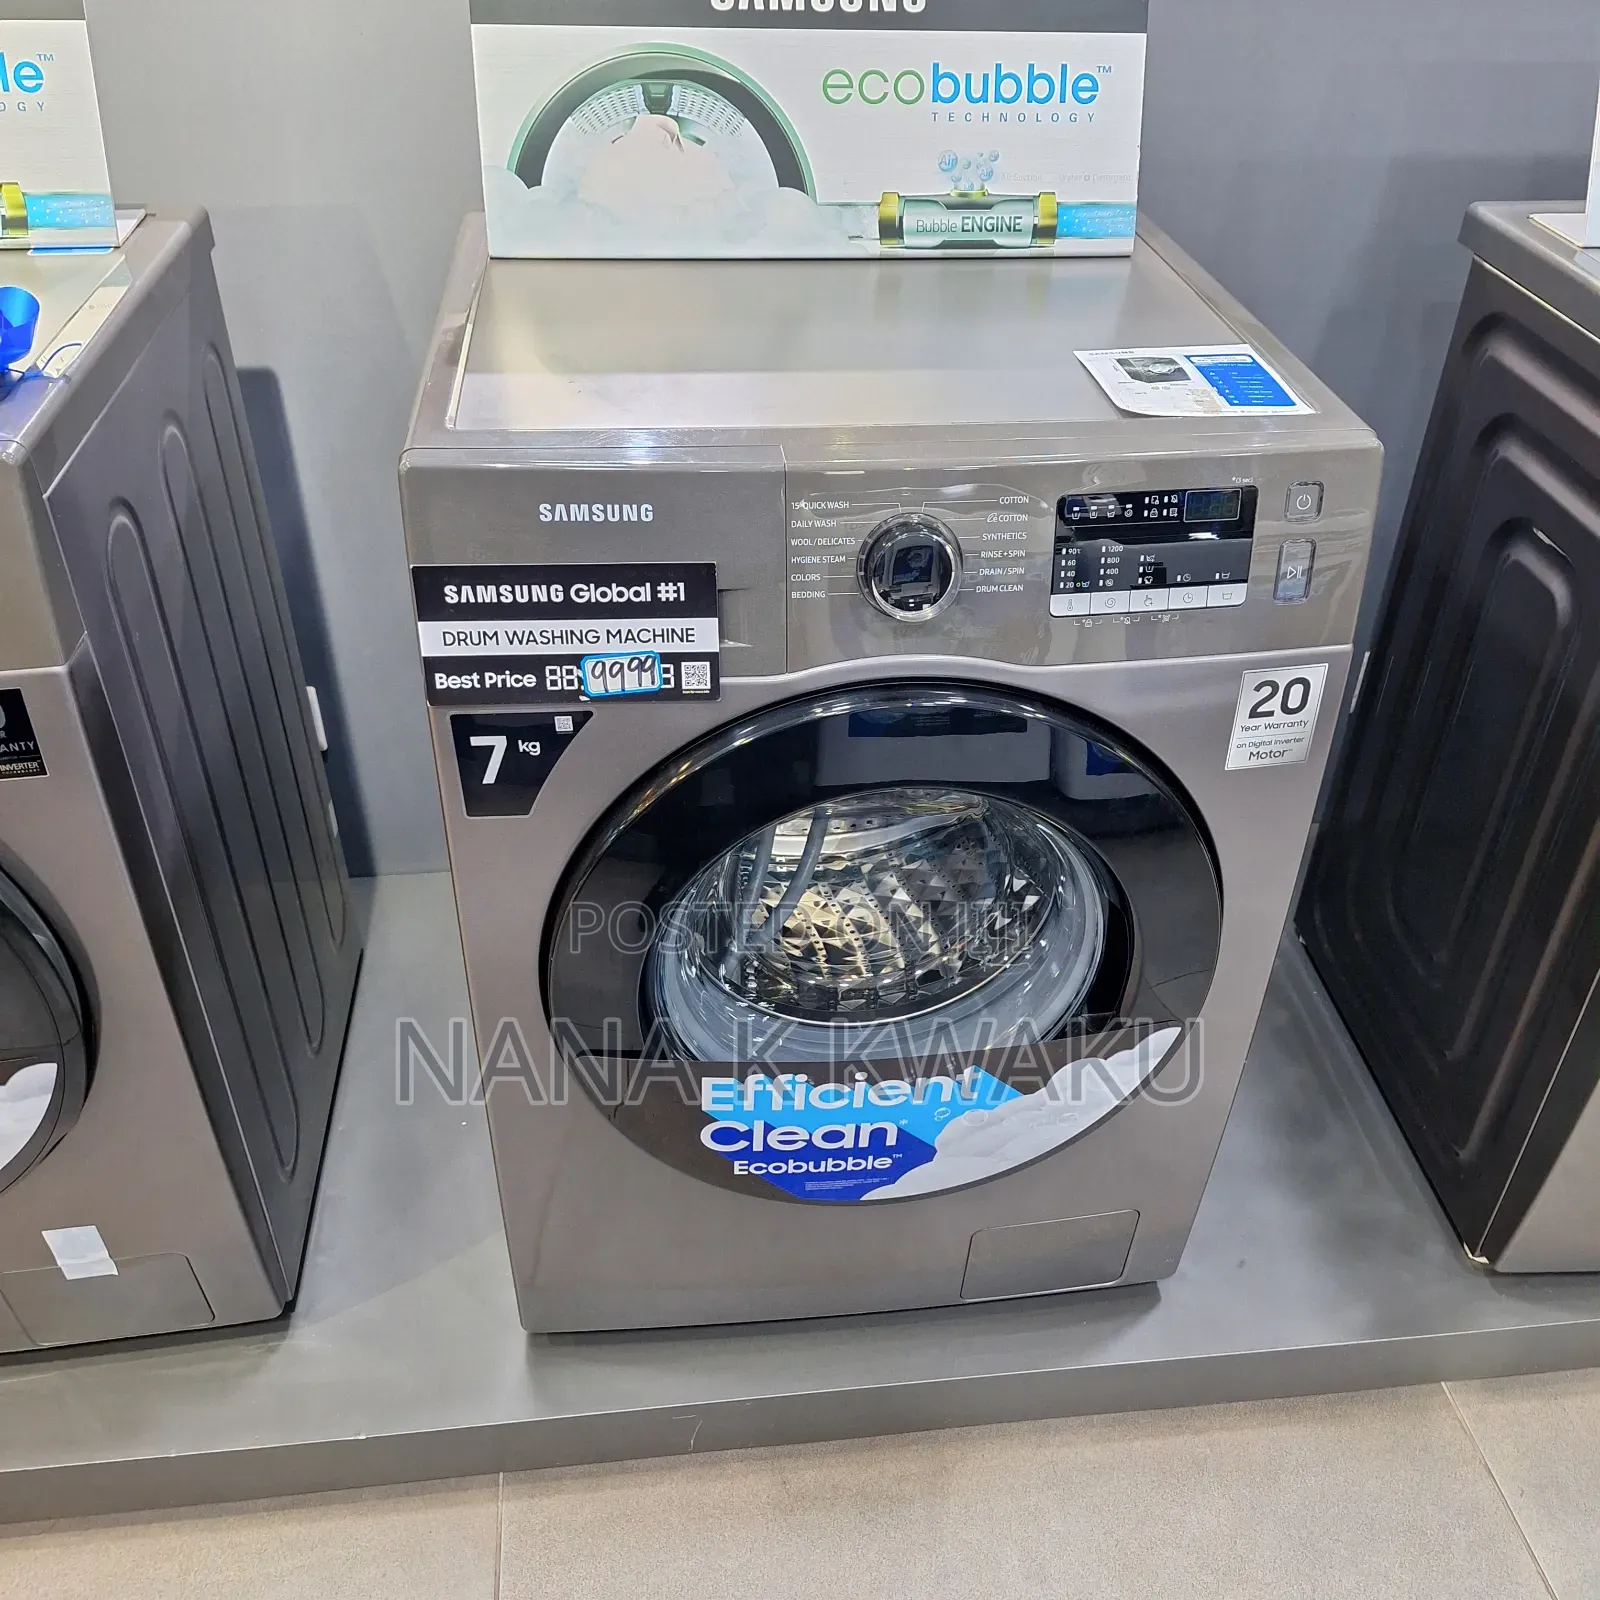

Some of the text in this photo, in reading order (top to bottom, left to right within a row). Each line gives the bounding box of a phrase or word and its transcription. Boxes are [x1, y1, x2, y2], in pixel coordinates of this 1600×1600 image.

[931, 112, 1095, 123] TECHNOLOGY
[915, 216, 1023, 233] Bubble ENGINE
[999, 496, 1029, 504] COTTON
[803, 501, 826, 510] QUICK
[827, 501, 849, 509] WASH
[539, 503, 654, 522] SAMSUNG
[998, 514, 1028, 522] COTTON
[791, 520, 837, 528] DAILY WASH
[982, 532, 1027, 541] SYNTHETICS
[1107, 545, 1124, 553] 1200
[791, 555, 846, 564] HYGIENE STEAM
[791, 573, 821, 582] COLORS
[443, 582, 686, 604] SAMSUNG Global #1
[976, 584, 1024, 593] DRUM CLEAN
[791, 590, 826, 598] BEDDING
[442, 627, 696, 647] DRUM WASHING MACHINE
[590, 655, 656, 693] 9999
[435, 672, 481, 689] Best
[485, 670, 537, 689] Price
[1248, 676, 1312, 719] 20
[1240, 719, 1309, 733] Year Warranty
[1248, 739, 1273, 749] Digital
[469, 735, 541, 785] 7 kg
[700, 1065, 982, 1112] Efficient
